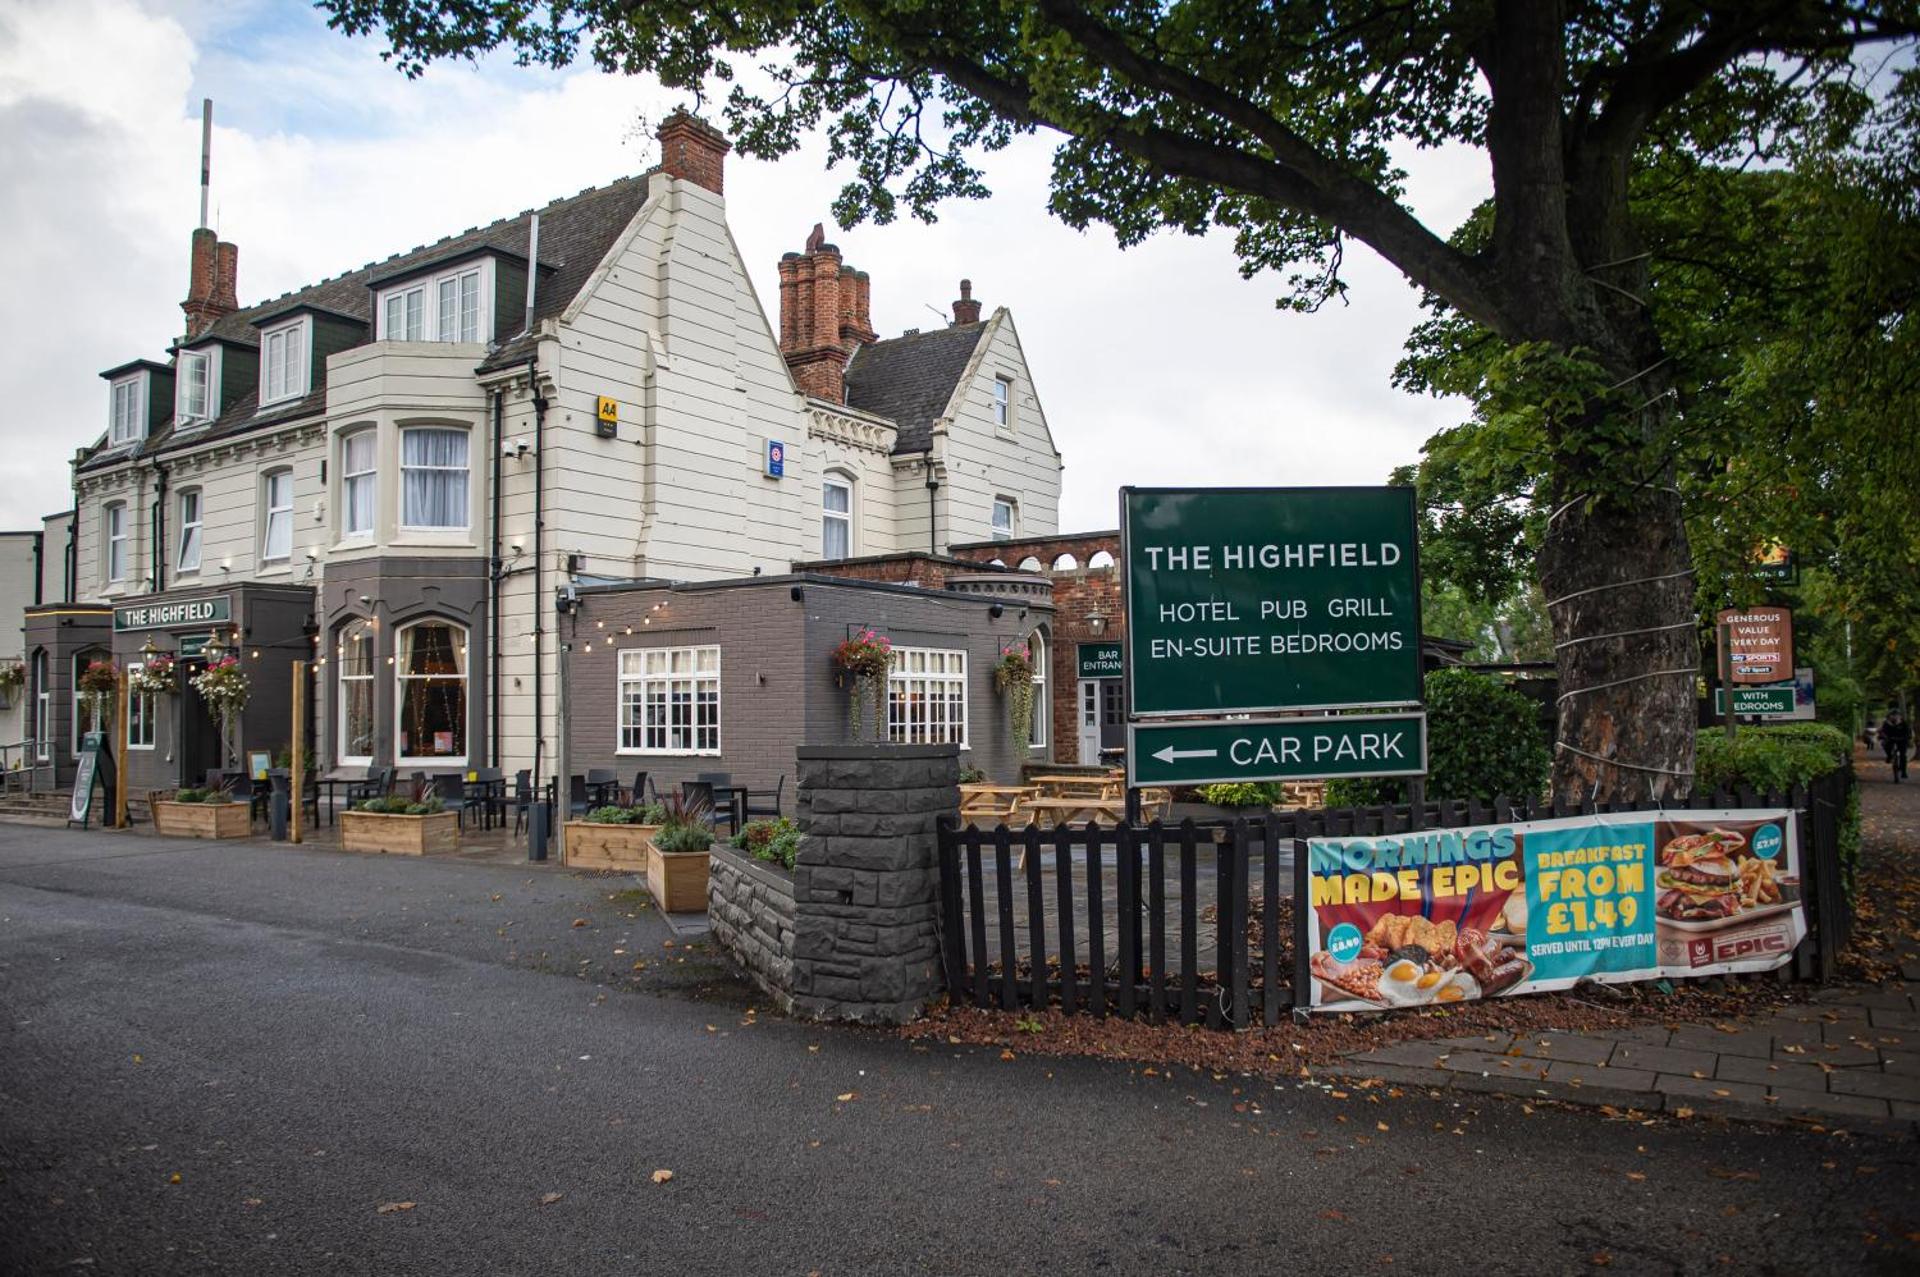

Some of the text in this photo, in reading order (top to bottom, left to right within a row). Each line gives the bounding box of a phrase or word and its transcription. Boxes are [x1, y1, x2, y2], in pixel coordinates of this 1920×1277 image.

[602, 402, 616, 416] AA
[1145, 543, 1401, 571] THE HIGHFIELD
[126, 602, 214, 626] THE HIGHFIELD
[1160, 598, 1393, 623] HOTEL PUB GRILL
[1726, 614, 1780, 623] GENEROUS
[1738, 626, 1770, 635] VALUE
[1760, 636, 1780, 645] DAY
[1098, 651, 1118, 660] BAR
[1151, 632, 1403, 659] EN-SUITE BEDROOMS
[1083, 661, 1122, 670] ENTRAN
[1734, 702, 1784, 710] EDROOMS
[1742, 692, 1768, 700] WITH
[1230, 733, 1404, 765] CAR PARK
[1311, 828, 1516, 871] MORNINGS
[1538, 844, 1645, 868] BREAKFAST
[1312, 861, 1519, 906] MADE EPIC
[1538, 863, 1645, 902] FROM
[1546, 896, 1638, 935] £1.49
[1532, 944, 1563, 956] SERVED
[1565, 940, 1591, 952] UNTIL
[1613, 934, 1636, 948] EVERY
[1637, 933, 1654, 945] DAY
[1717, 935, 1785, 959] EPIC
